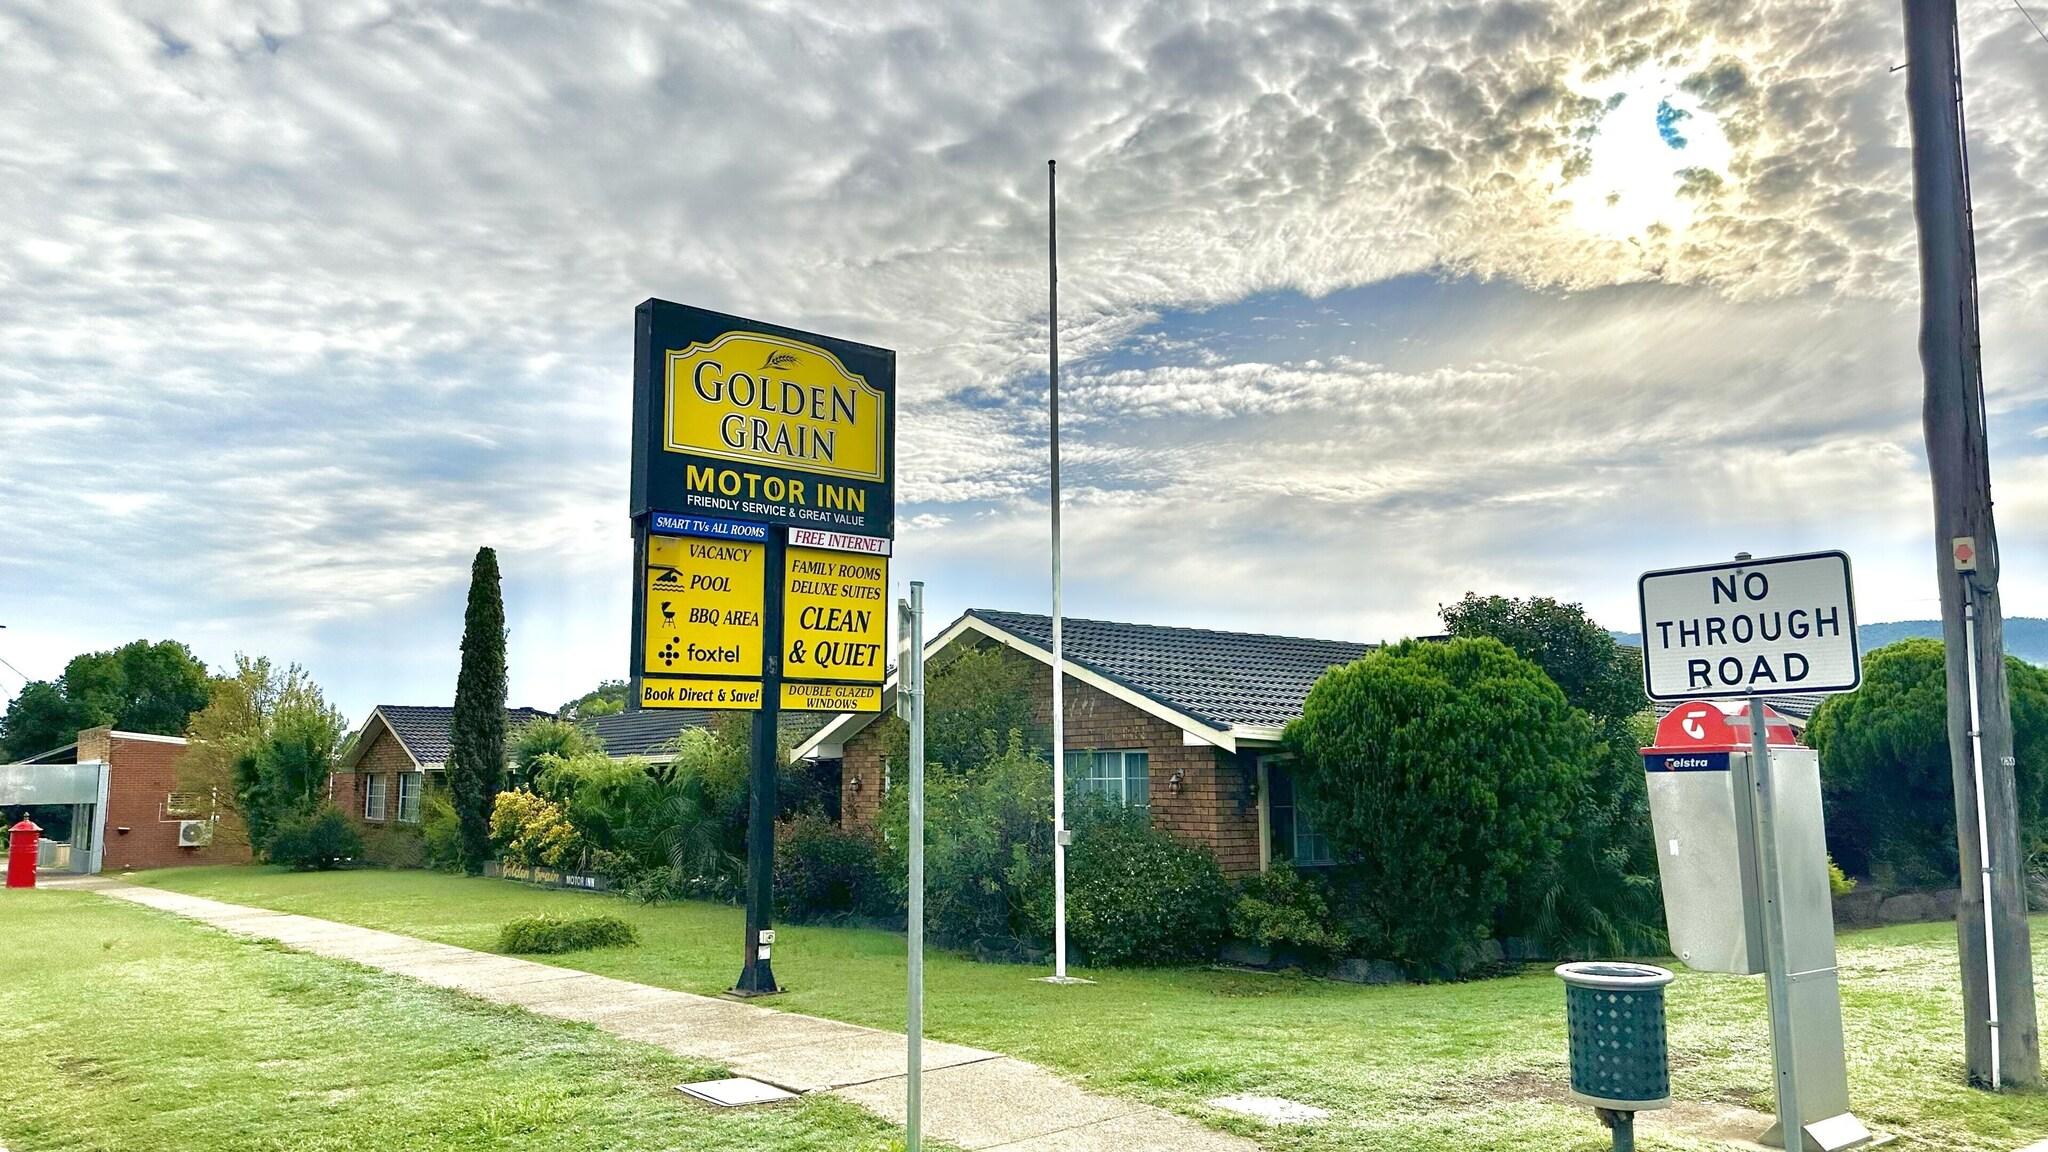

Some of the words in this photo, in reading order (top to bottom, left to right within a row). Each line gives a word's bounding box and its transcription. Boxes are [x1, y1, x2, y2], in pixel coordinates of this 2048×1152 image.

[693, 360, 858, 425] GOLDEN
[720, 414, 836, 463] GRAIN
[686, 465, 805, 505] MOTOR
[818, 483, 865, 512] INN
[688, 495, 739, 511] FRIENDLY
[742, 502, 786, 516] SERVICE
[789, 508, 795, 517] &
[799, 509, 832, 521] GREAT
[833, 514, 865, 526] VALUE
[656, 517, 691, 530] SMART
[693, 521, 709, 532] TVs
[711, 523, 728, 533] ALL
[731, 525, 765, 537] ROOMS
[795, 531, 824, 545] FREE
[828, 535, 884, 552] INTERNET
[690, 544, 751, 562] VACANCY
[791, 560, 837, 575] FAMILY
[838, 566, 881, 580] ROOMS
[690, 575, 731, 592] POOL
[791, 580, 837, 596] DELUXE
[841, 585, 881, 600] SUITES
[1712, 572, 1769, 604] NO
[689, 608, 720, 626] BBQ
[724, 611, 759, 626] AREA
[800, 607, 871, 633] CLEAN
[1656, 607, 1839, 648] THROUGH
[688, 643, 739, 662] foxtel
[789, 640, 806, 663] &
[815, 641, 880, 668] QUIET
[1688, 653, 1809, 687] ROAD
[644, 688, 674, 701] Book
[679, 688, 714, 702] Direct
[718, 690, 726, 702] &
[730, 689, 759, 703] Save!
[788, 686, 831, 696] DOUBLE
[835, 687, 874, 698] GLAZED
[806, 698, 858, 709] WINDOWS
[1664, 758, 1708, 771] Telstra
[566, 875, 584, 886] MOTOR
[585, 877, 595, 887] INN
